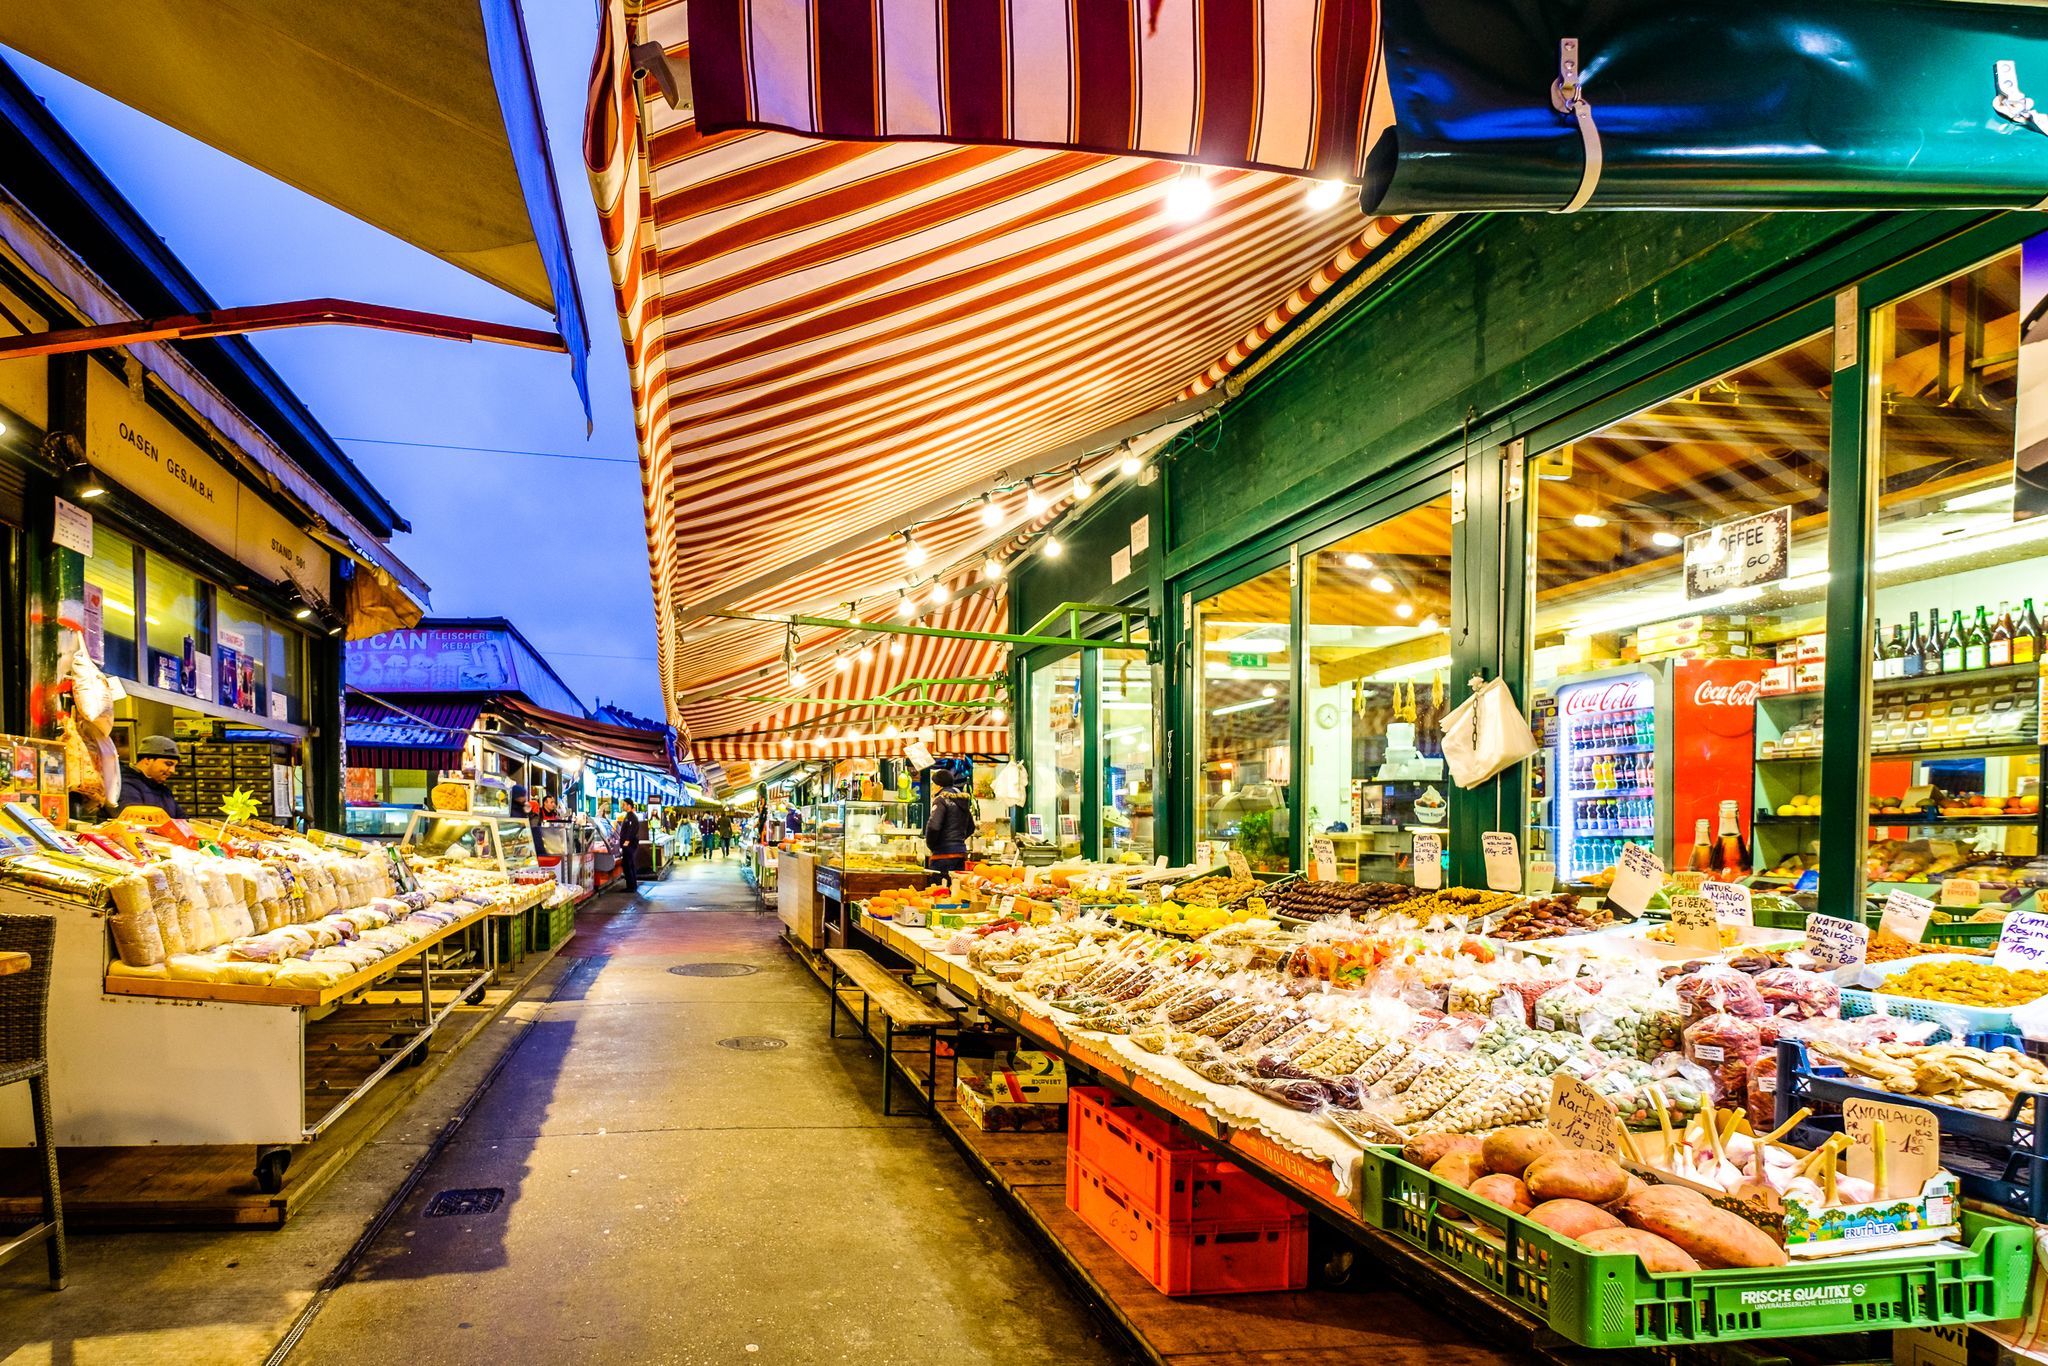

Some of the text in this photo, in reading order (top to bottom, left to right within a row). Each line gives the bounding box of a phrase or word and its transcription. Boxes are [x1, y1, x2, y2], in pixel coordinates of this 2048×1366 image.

[118, 422, 215, 504] OASEN GES.M.B.H.
[271, 537, 293, 561] STAND
[1746, 553, 1770, 569] GO
[1565, 681, 1642, 716] Coca-Cola
[1702, 884, 1732, 893] NATUR
[1710, 892, 1744, 902] MANGO
[1671, 897, 1706, 908] FEIGEN
[1813, 916, 1854, 933] NATUR
[1809, 925, 1866, 946] APRIKOSEN
[1741, 1288, 1792, 1305] FRISCHE
